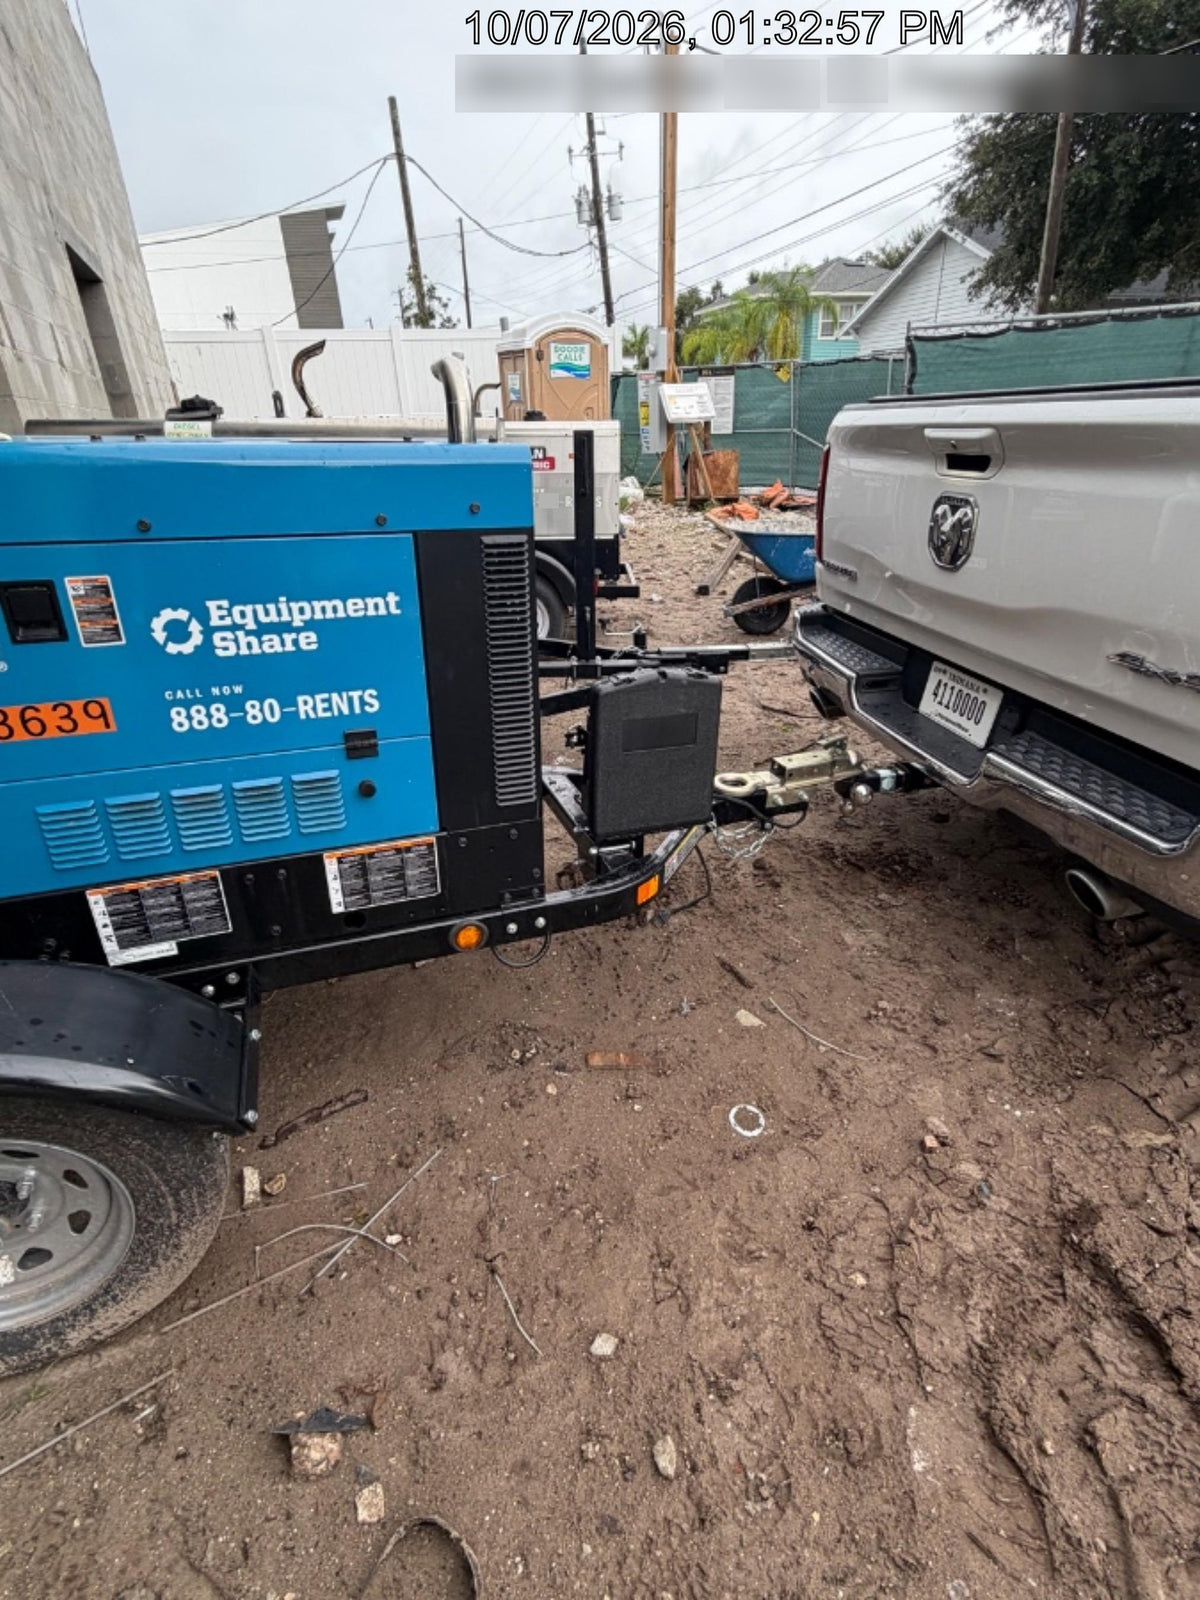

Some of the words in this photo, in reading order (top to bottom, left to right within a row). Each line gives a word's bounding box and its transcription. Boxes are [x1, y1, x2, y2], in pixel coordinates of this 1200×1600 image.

[205, 591, 401, 630] Equipment
[212, 630, 319, 657] Share
[164, 688, 204, 701] CALL
[211, 684, 243, 697] NOW
[170, 689, 380, 733] 888-80-RENTS
[932, 678, 987, 726] 4110000
